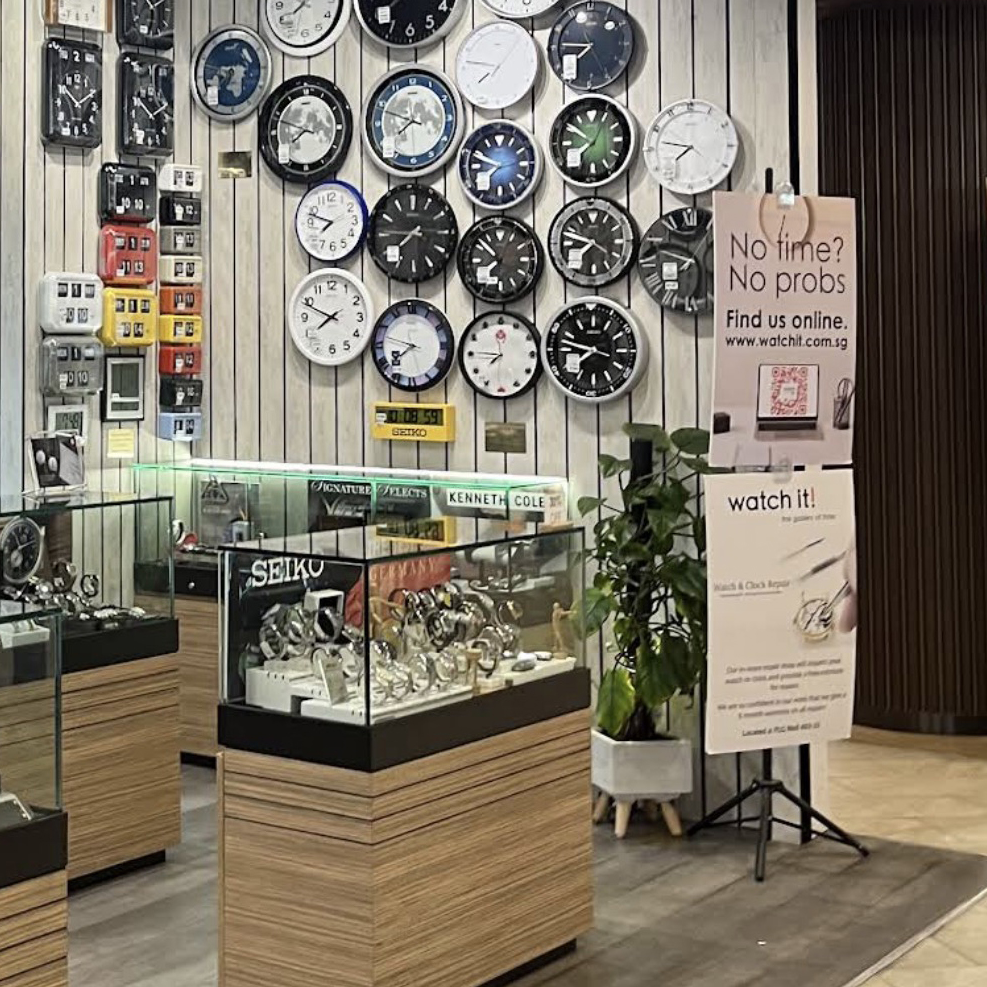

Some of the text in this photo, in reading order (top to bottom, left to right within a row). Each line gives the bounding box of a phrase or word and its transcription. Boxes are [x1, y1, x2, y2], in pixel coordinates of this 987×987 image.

[405, 23, 415, 36] 6
[425, 15, 434, 28] 5
[731, 232, 844, 264] No time?
[729, 265, 846, 299] No probs
[727, 310, 848, 330] Find us online.
[725, 334, 848, 350] www.watchit.com.sg
[392, 427, 427, 438] SEIKO
[449, 491, 507, 507] KENNETH
[514, 495, 545, 508] COLE
[728, 487, 815, 512] watch it!
[251, 555, 324, 588] SEIKO
